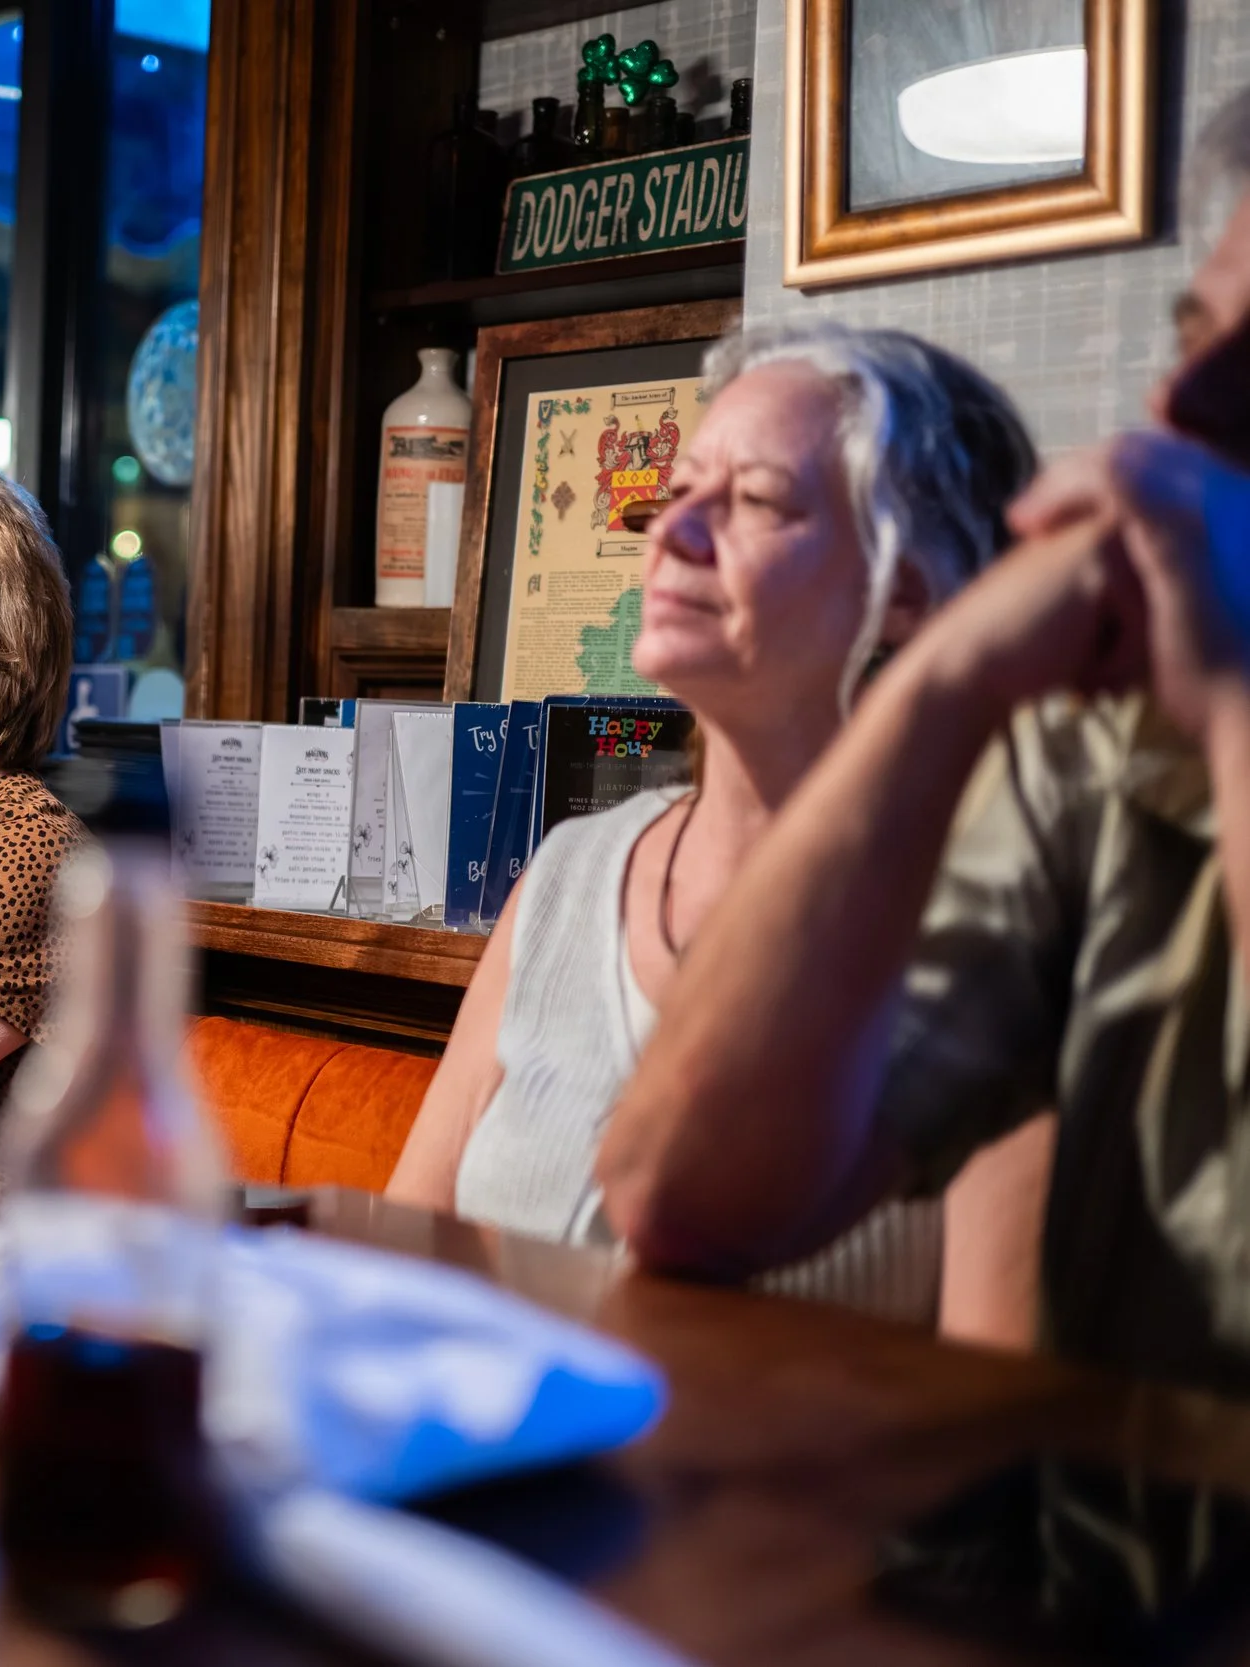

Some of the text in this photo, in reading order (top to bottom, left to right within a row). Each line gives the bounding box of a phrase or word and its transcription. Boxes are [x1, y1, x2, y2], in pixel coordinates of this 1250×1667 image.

[512, 172, 635, 261] DODGER
[467, 726, 497, 752] Try
[588, 716, 663, 740] Happy
[595, 737, 653, 758] Hour
[598, 783, 646, 792] LIBATIONS
